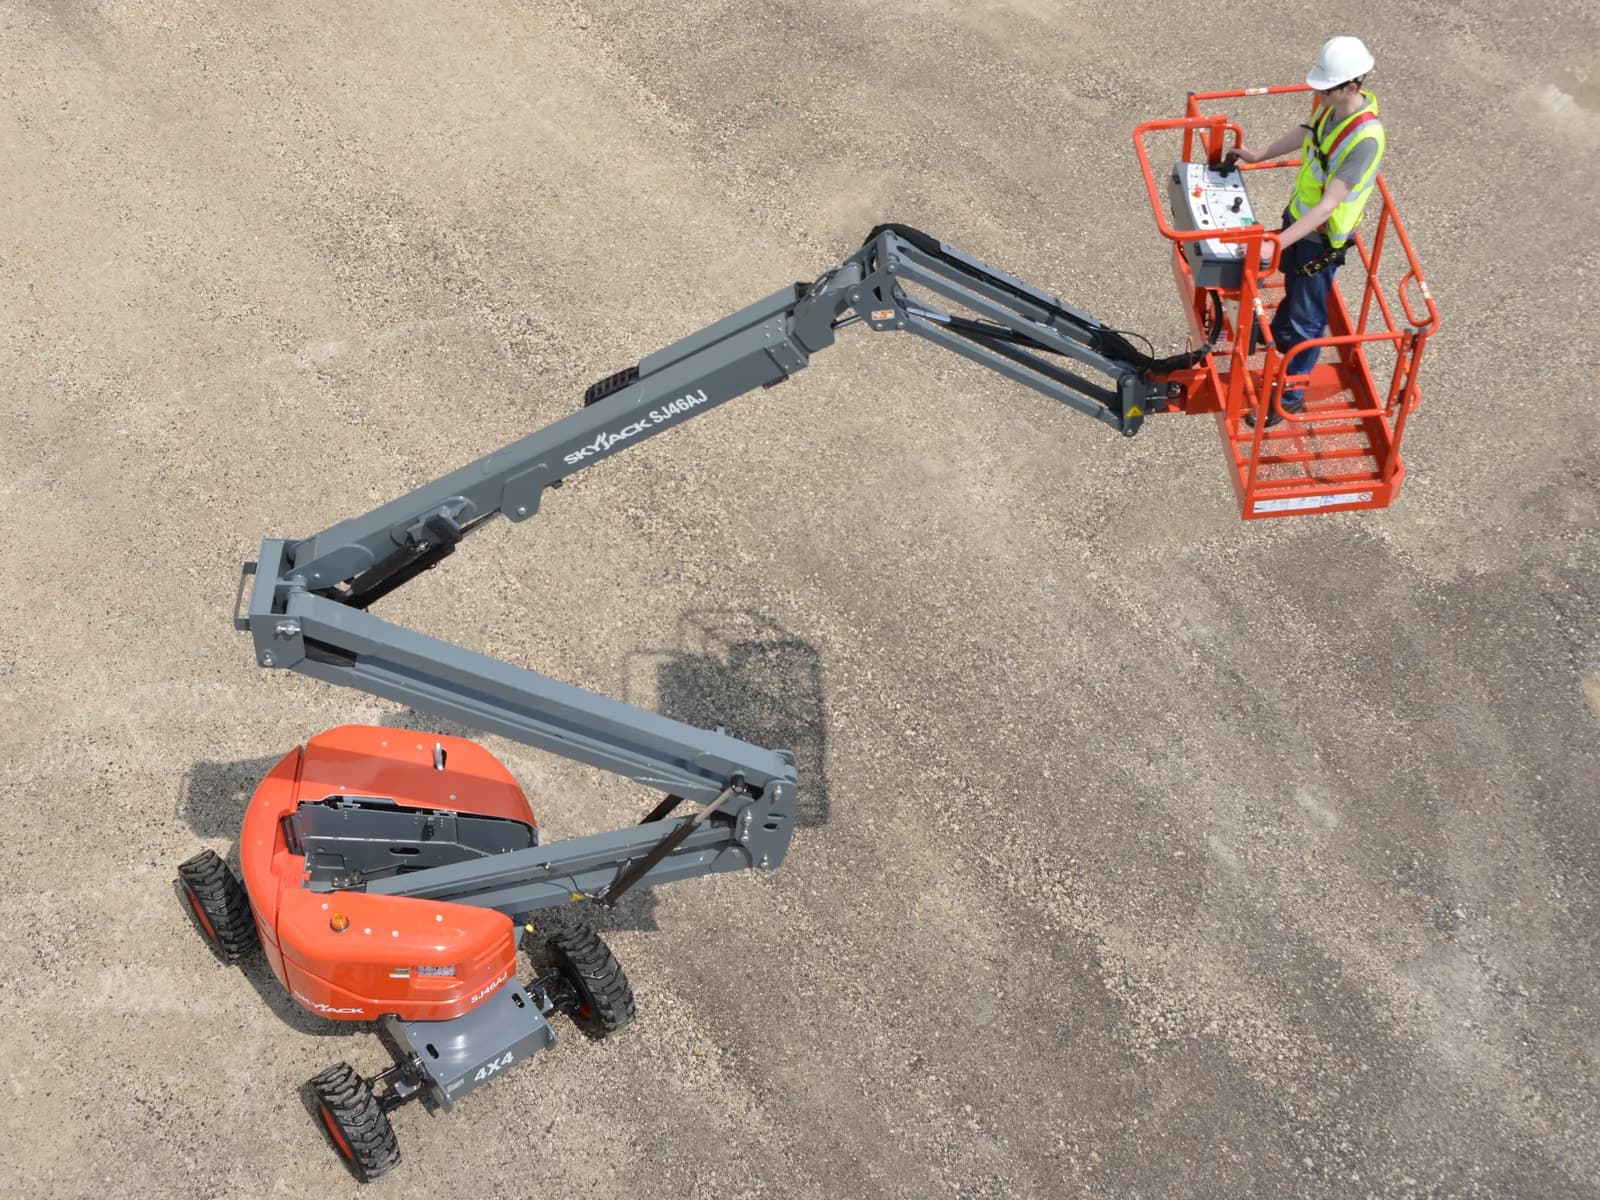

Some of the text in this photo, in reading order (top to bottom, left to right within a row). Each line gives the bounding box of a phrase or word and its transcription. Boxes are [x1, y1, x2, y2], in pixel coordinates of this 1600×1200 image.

[563, 389, 708, 465] SKYJACK SJ46AJ
[474, 1051, 514, 1083] 4X4
